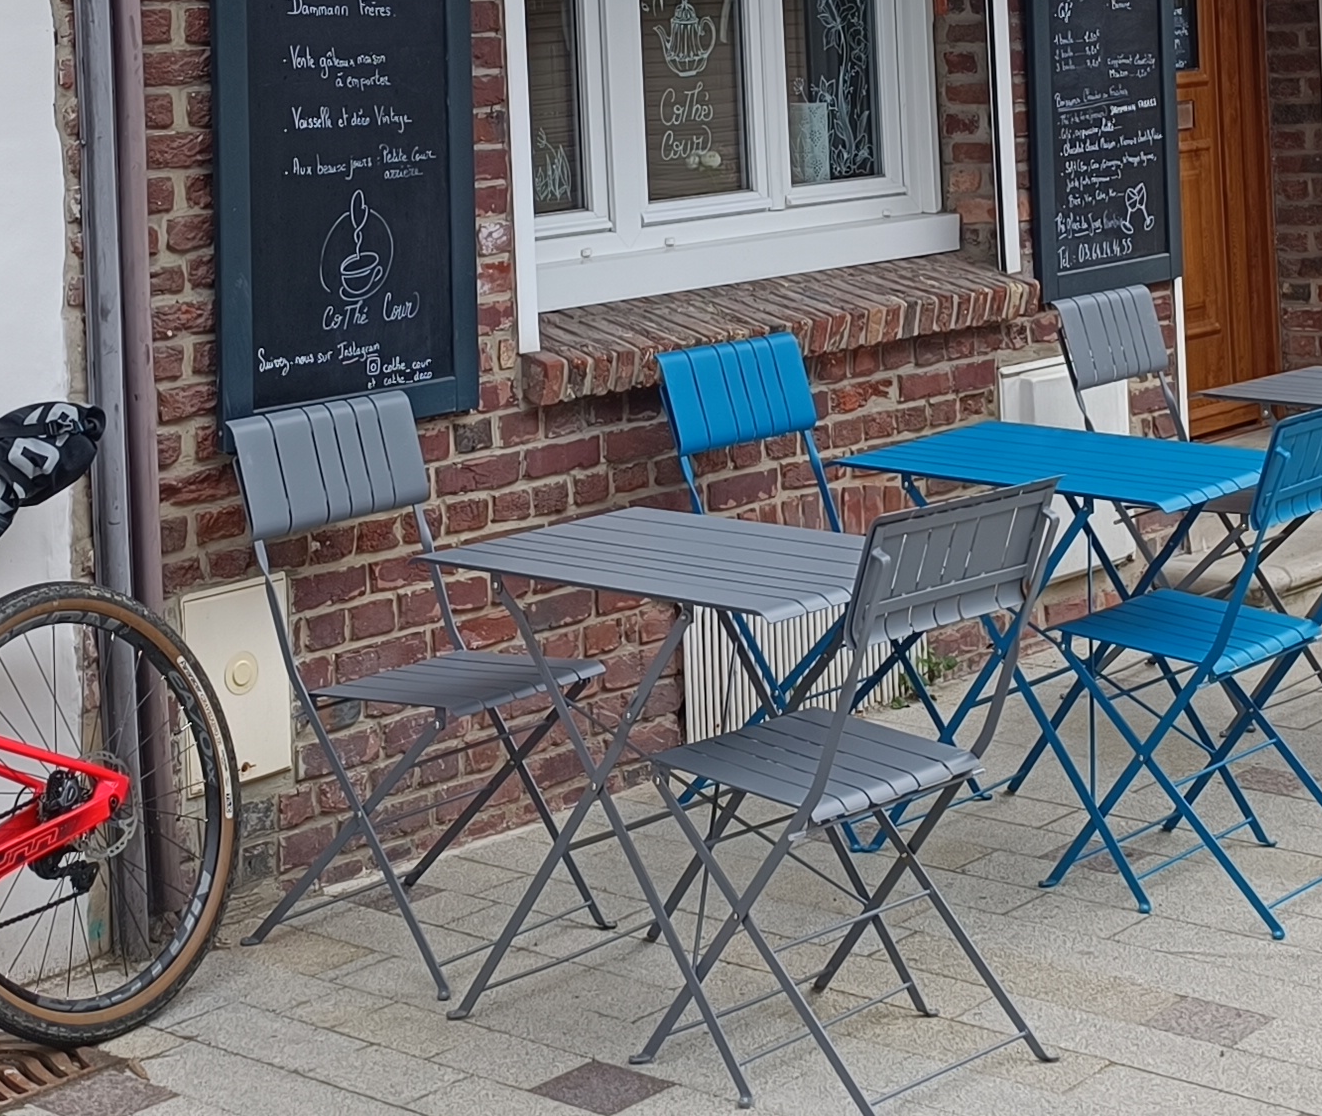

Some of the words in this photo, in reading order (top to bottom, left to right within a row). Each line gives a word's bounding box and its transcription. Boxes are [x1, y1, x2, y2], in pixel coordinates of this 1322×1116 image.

[290, 45, 315, 70] Vente
[356, 52, 386, 65] maison
[346, 69, 391, 92] emporter
[292, 105, 332, 131] Vaisselle
[338, 105, 349, 127] et
[374, 104, 412, 133] Vintage
[379, 144, 409, 163] Petite
[411, 145, 437, 162] Cour
[661, 125, 712, 161] Cour
[293, 156, 312, 175] Aux
[316, 153, 346, 175] beaux
[382, 291, 420, 323] Cour
[317, 350, 333, 365] sur
[337, 341, 380, 362] Instagram
